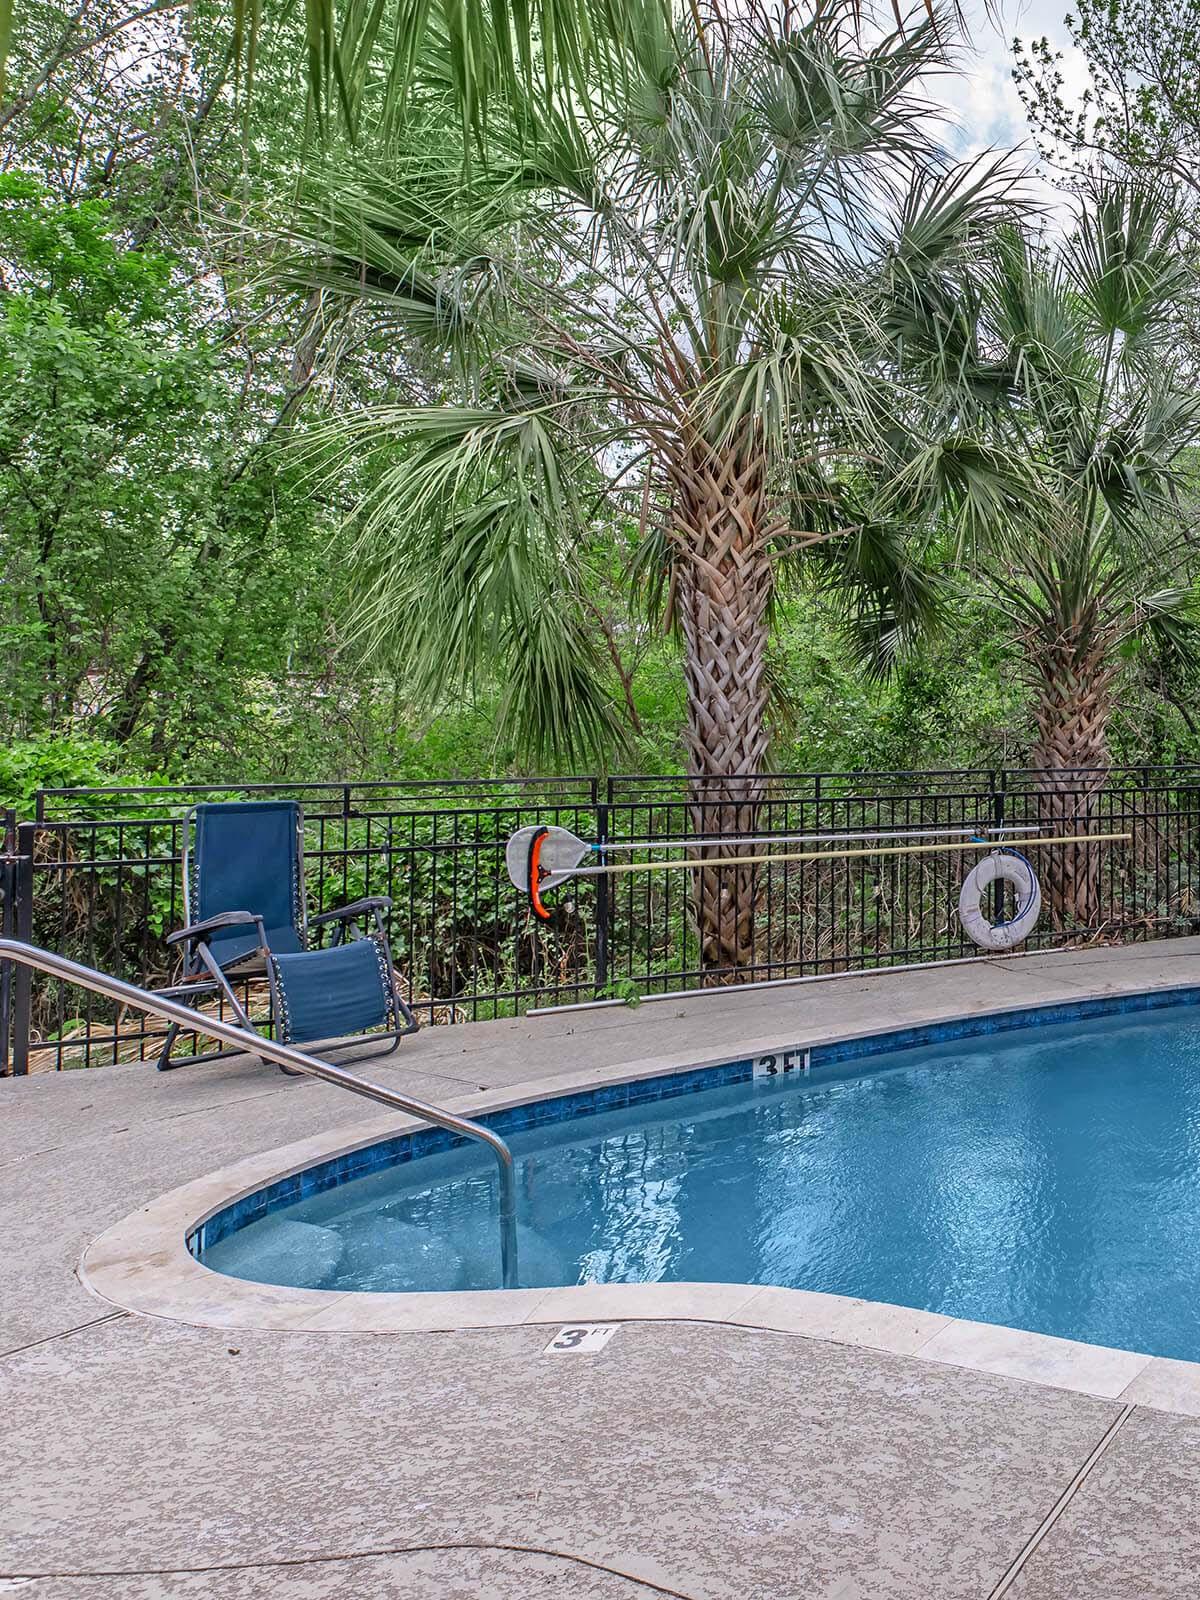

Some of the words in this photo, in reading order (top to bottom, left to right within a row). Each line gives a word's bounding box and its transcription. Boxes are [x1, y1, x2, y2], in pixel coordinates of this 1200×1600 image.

[758, 1055, 778, 1077] 3
[784, 1047, 809, 1073] FT
[553, 1329, 589, 1349] 3
[591, 1327, 613, 1336] FT
